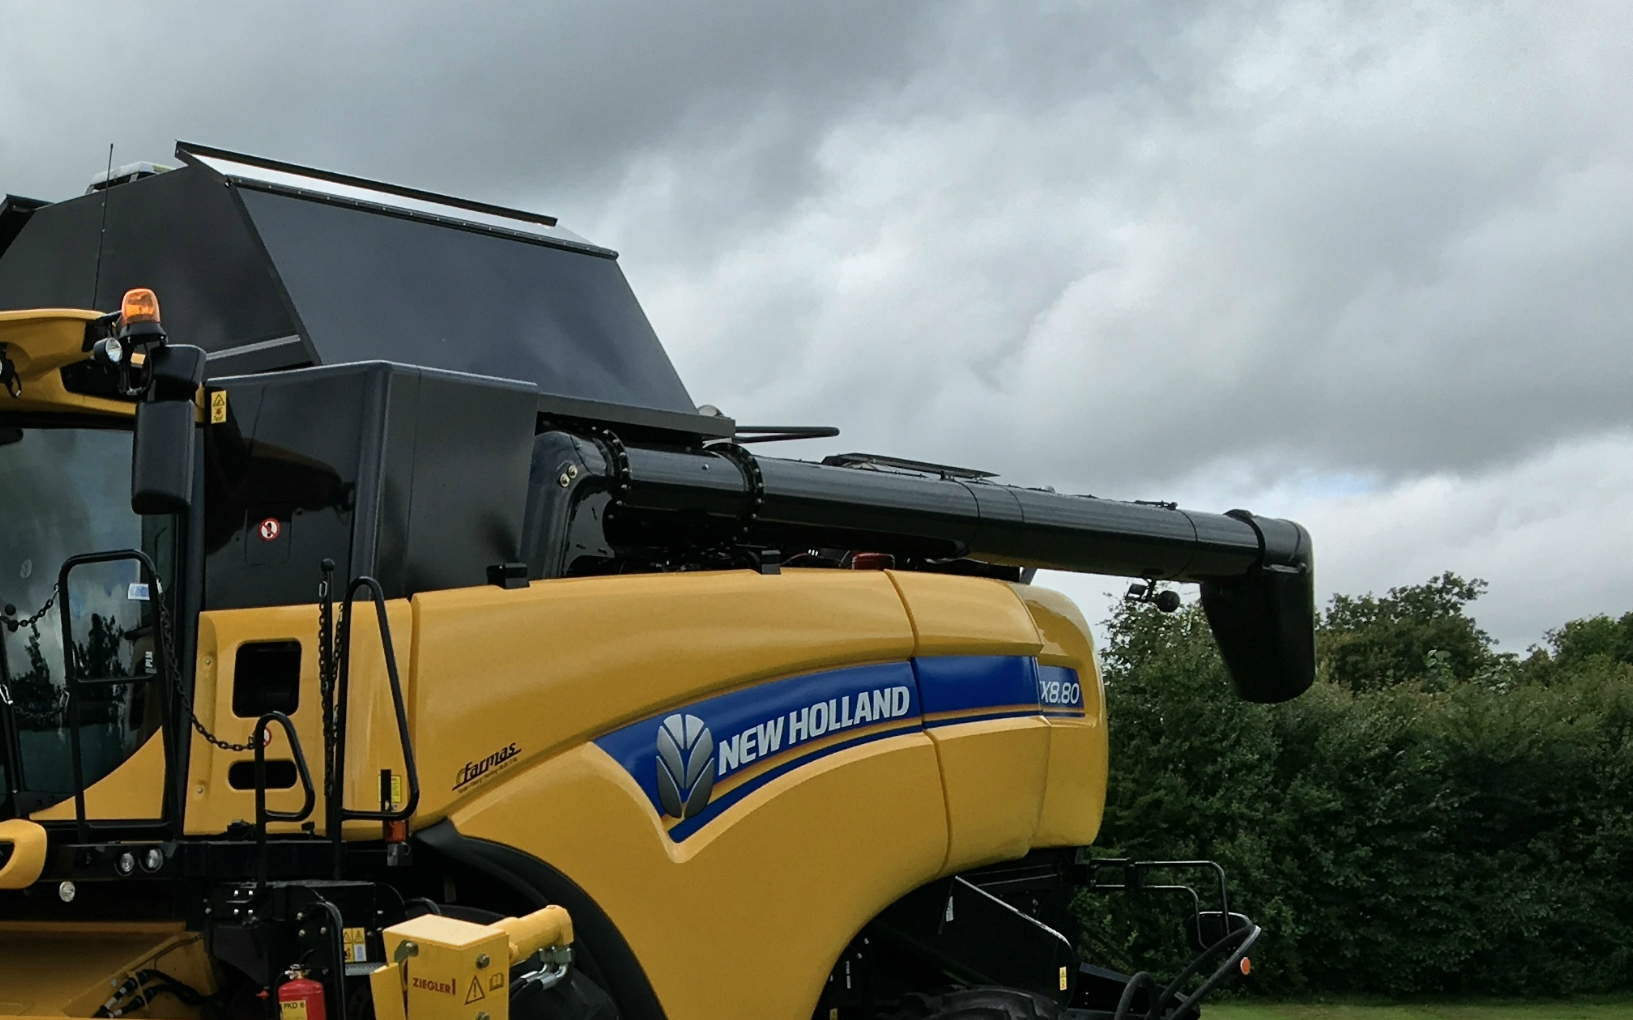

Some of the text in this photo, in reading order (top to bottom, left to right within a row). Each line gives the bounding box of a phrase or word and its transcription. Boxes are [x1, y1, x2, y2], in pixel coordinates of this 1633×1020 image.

[1039, 680, 1079, 704] X8.80
[718, 686, 910, 776] NEW HOLLAND
[412, 978, 451, 994] ZIEGLER
